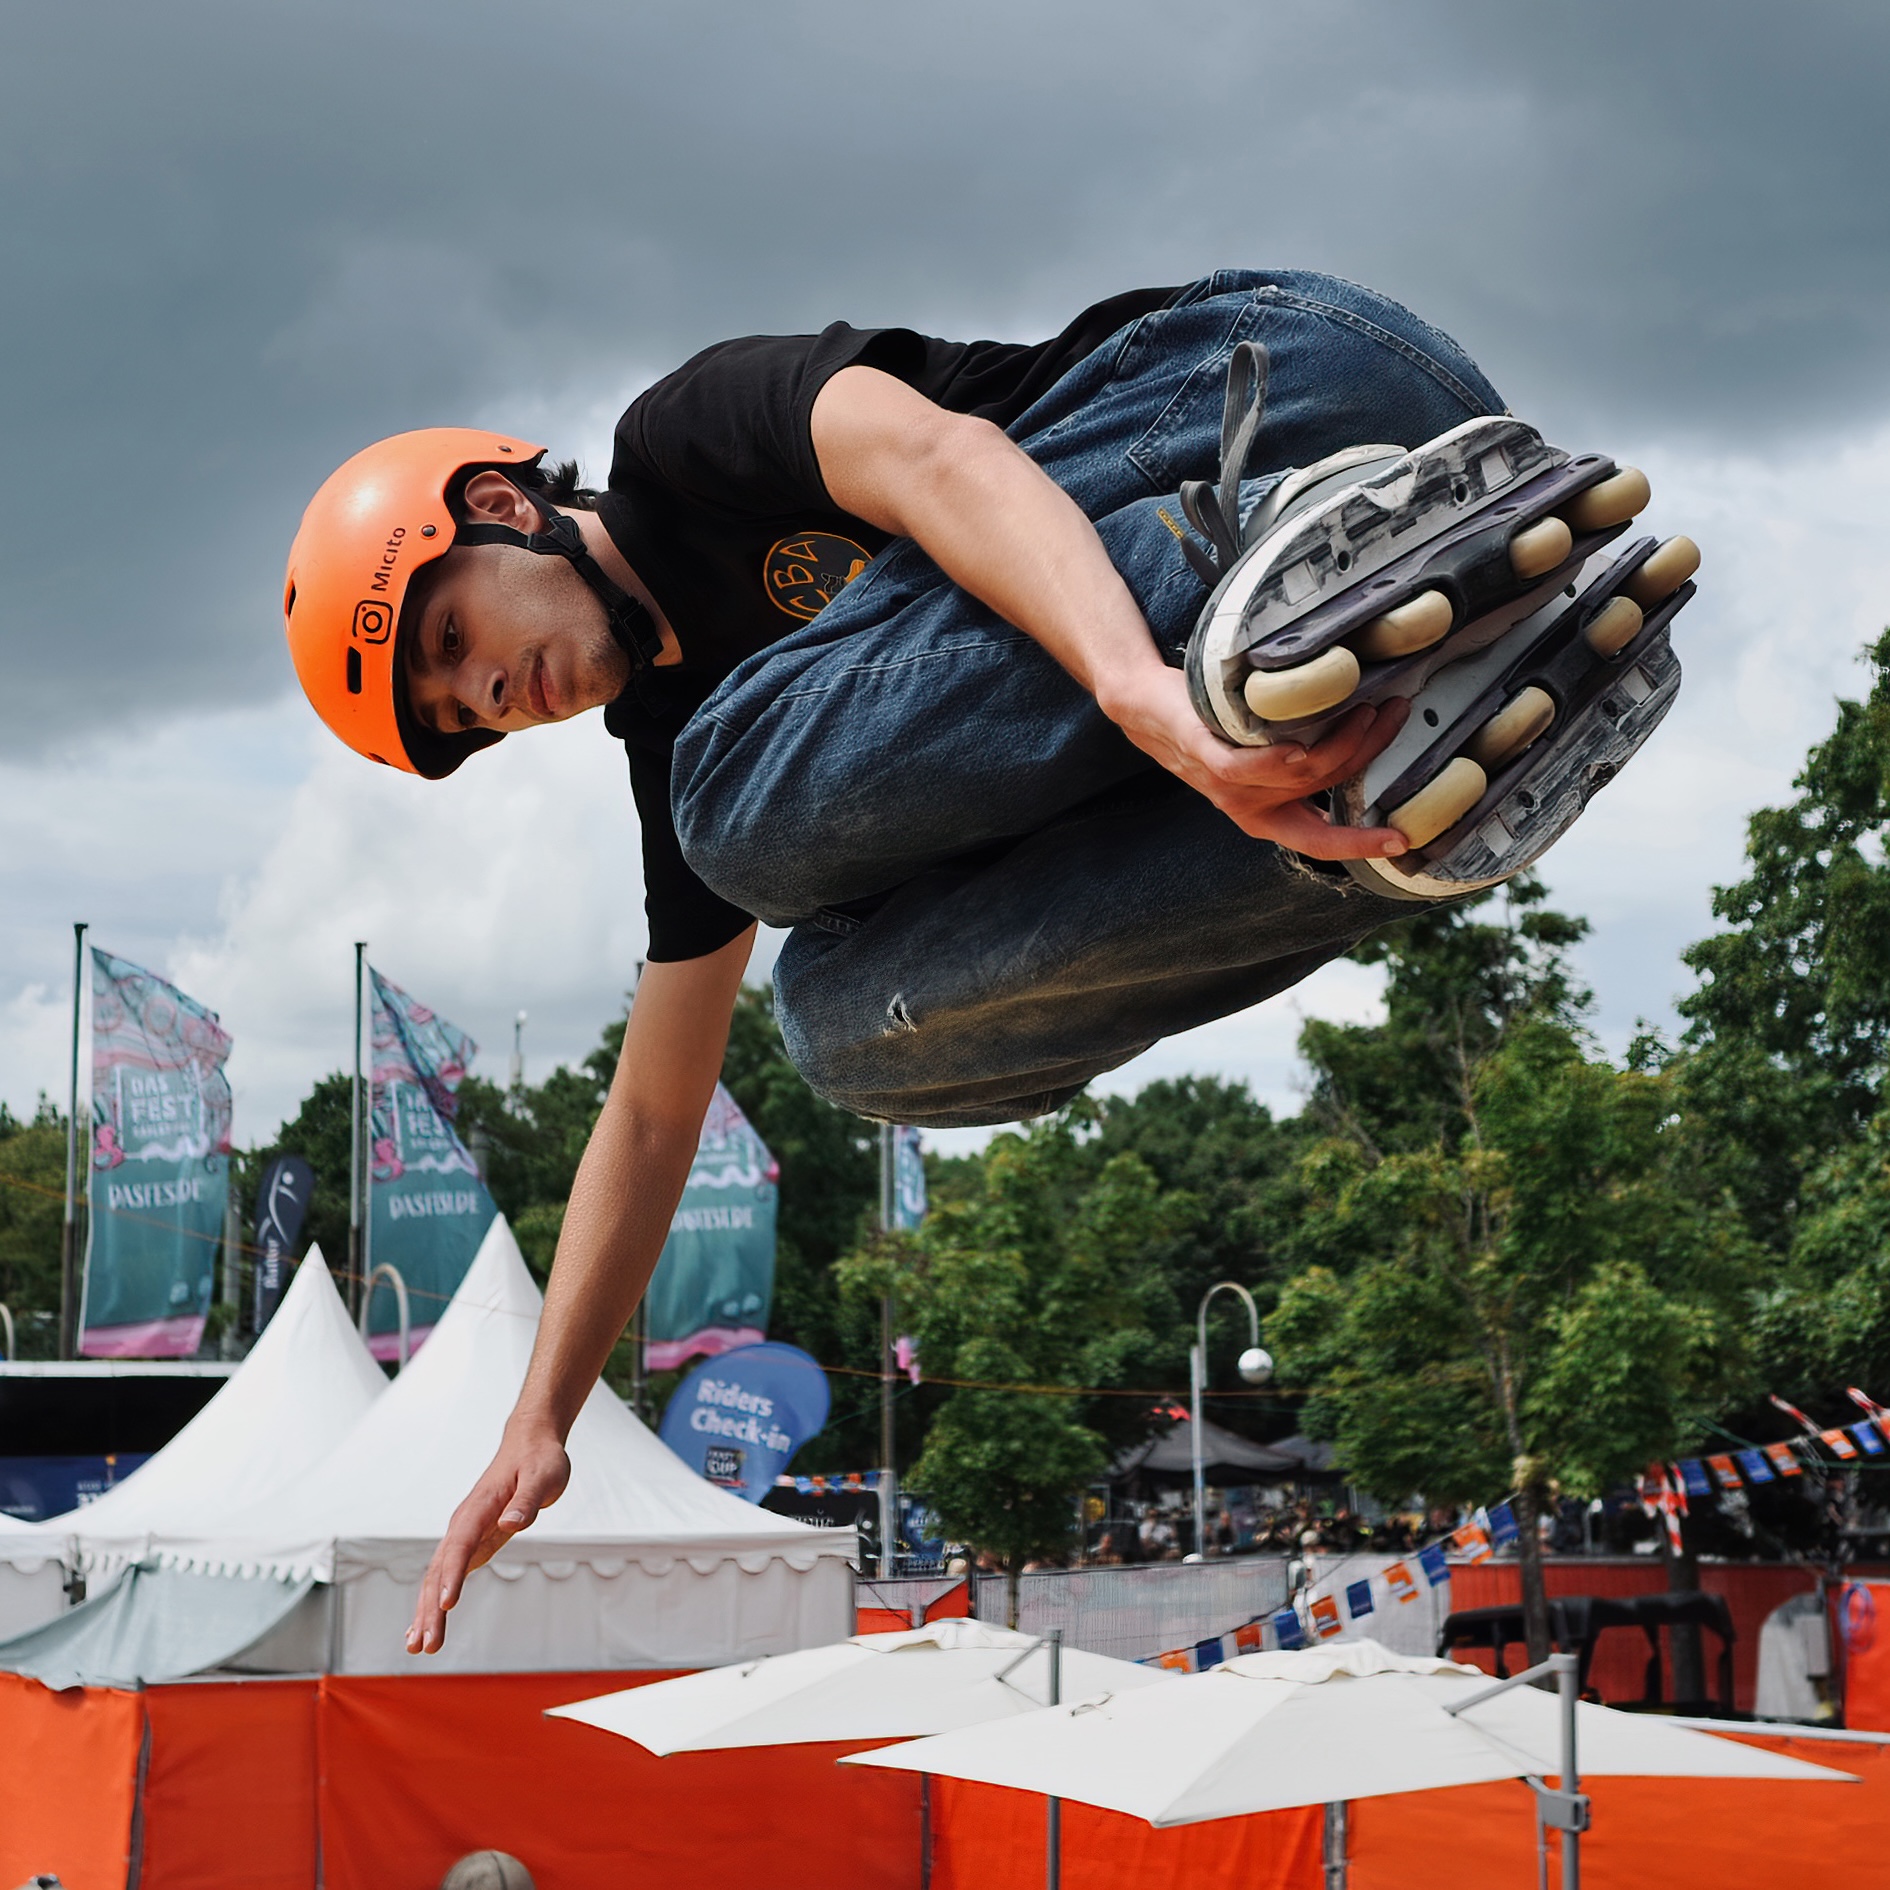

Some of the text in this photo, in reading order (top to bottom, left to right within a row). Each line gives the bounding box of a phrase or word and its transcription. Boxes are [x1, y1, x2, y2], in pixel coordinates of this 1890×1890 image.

[371, 527, 406, 591] Micito
[130, 1094, 197, 1123] FEST
[697, 1378, 774, 1417] Riders
[690, 1407, 792, 1454] Check-in
